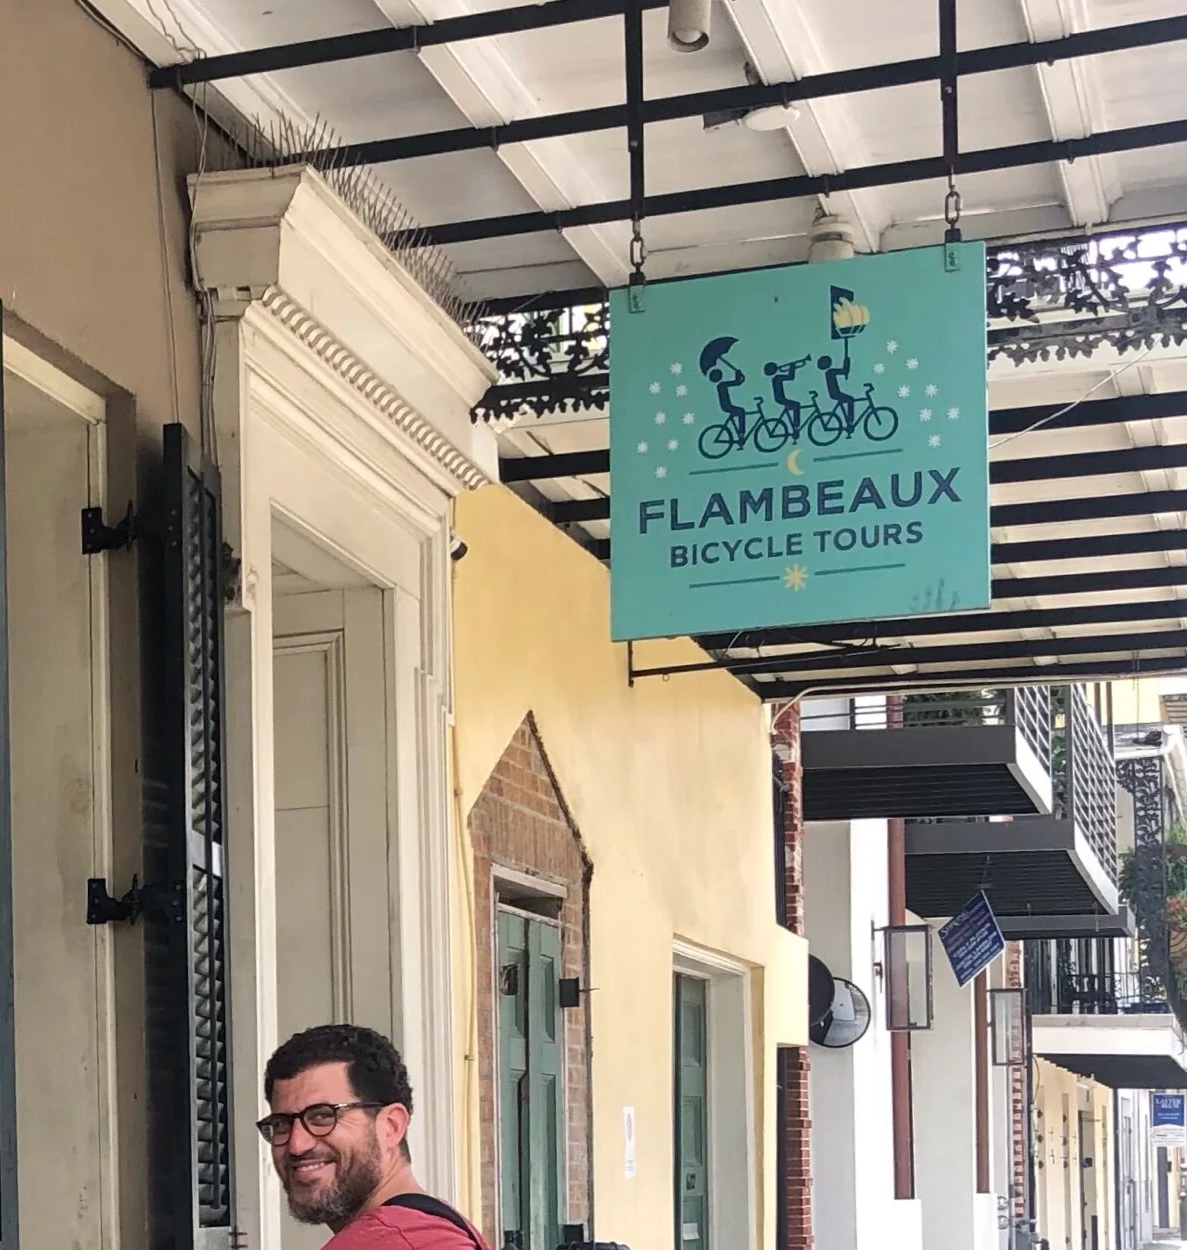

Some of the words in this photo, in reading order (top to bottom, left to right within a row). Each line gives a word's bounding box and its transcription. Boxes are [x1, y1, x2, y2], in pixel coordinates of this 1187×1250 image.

[639, 467, 962, 534] FLAMBEAUX
[669, 533, 803, 568] BICYCLE
[813, 521, 924, 553] TOURS
